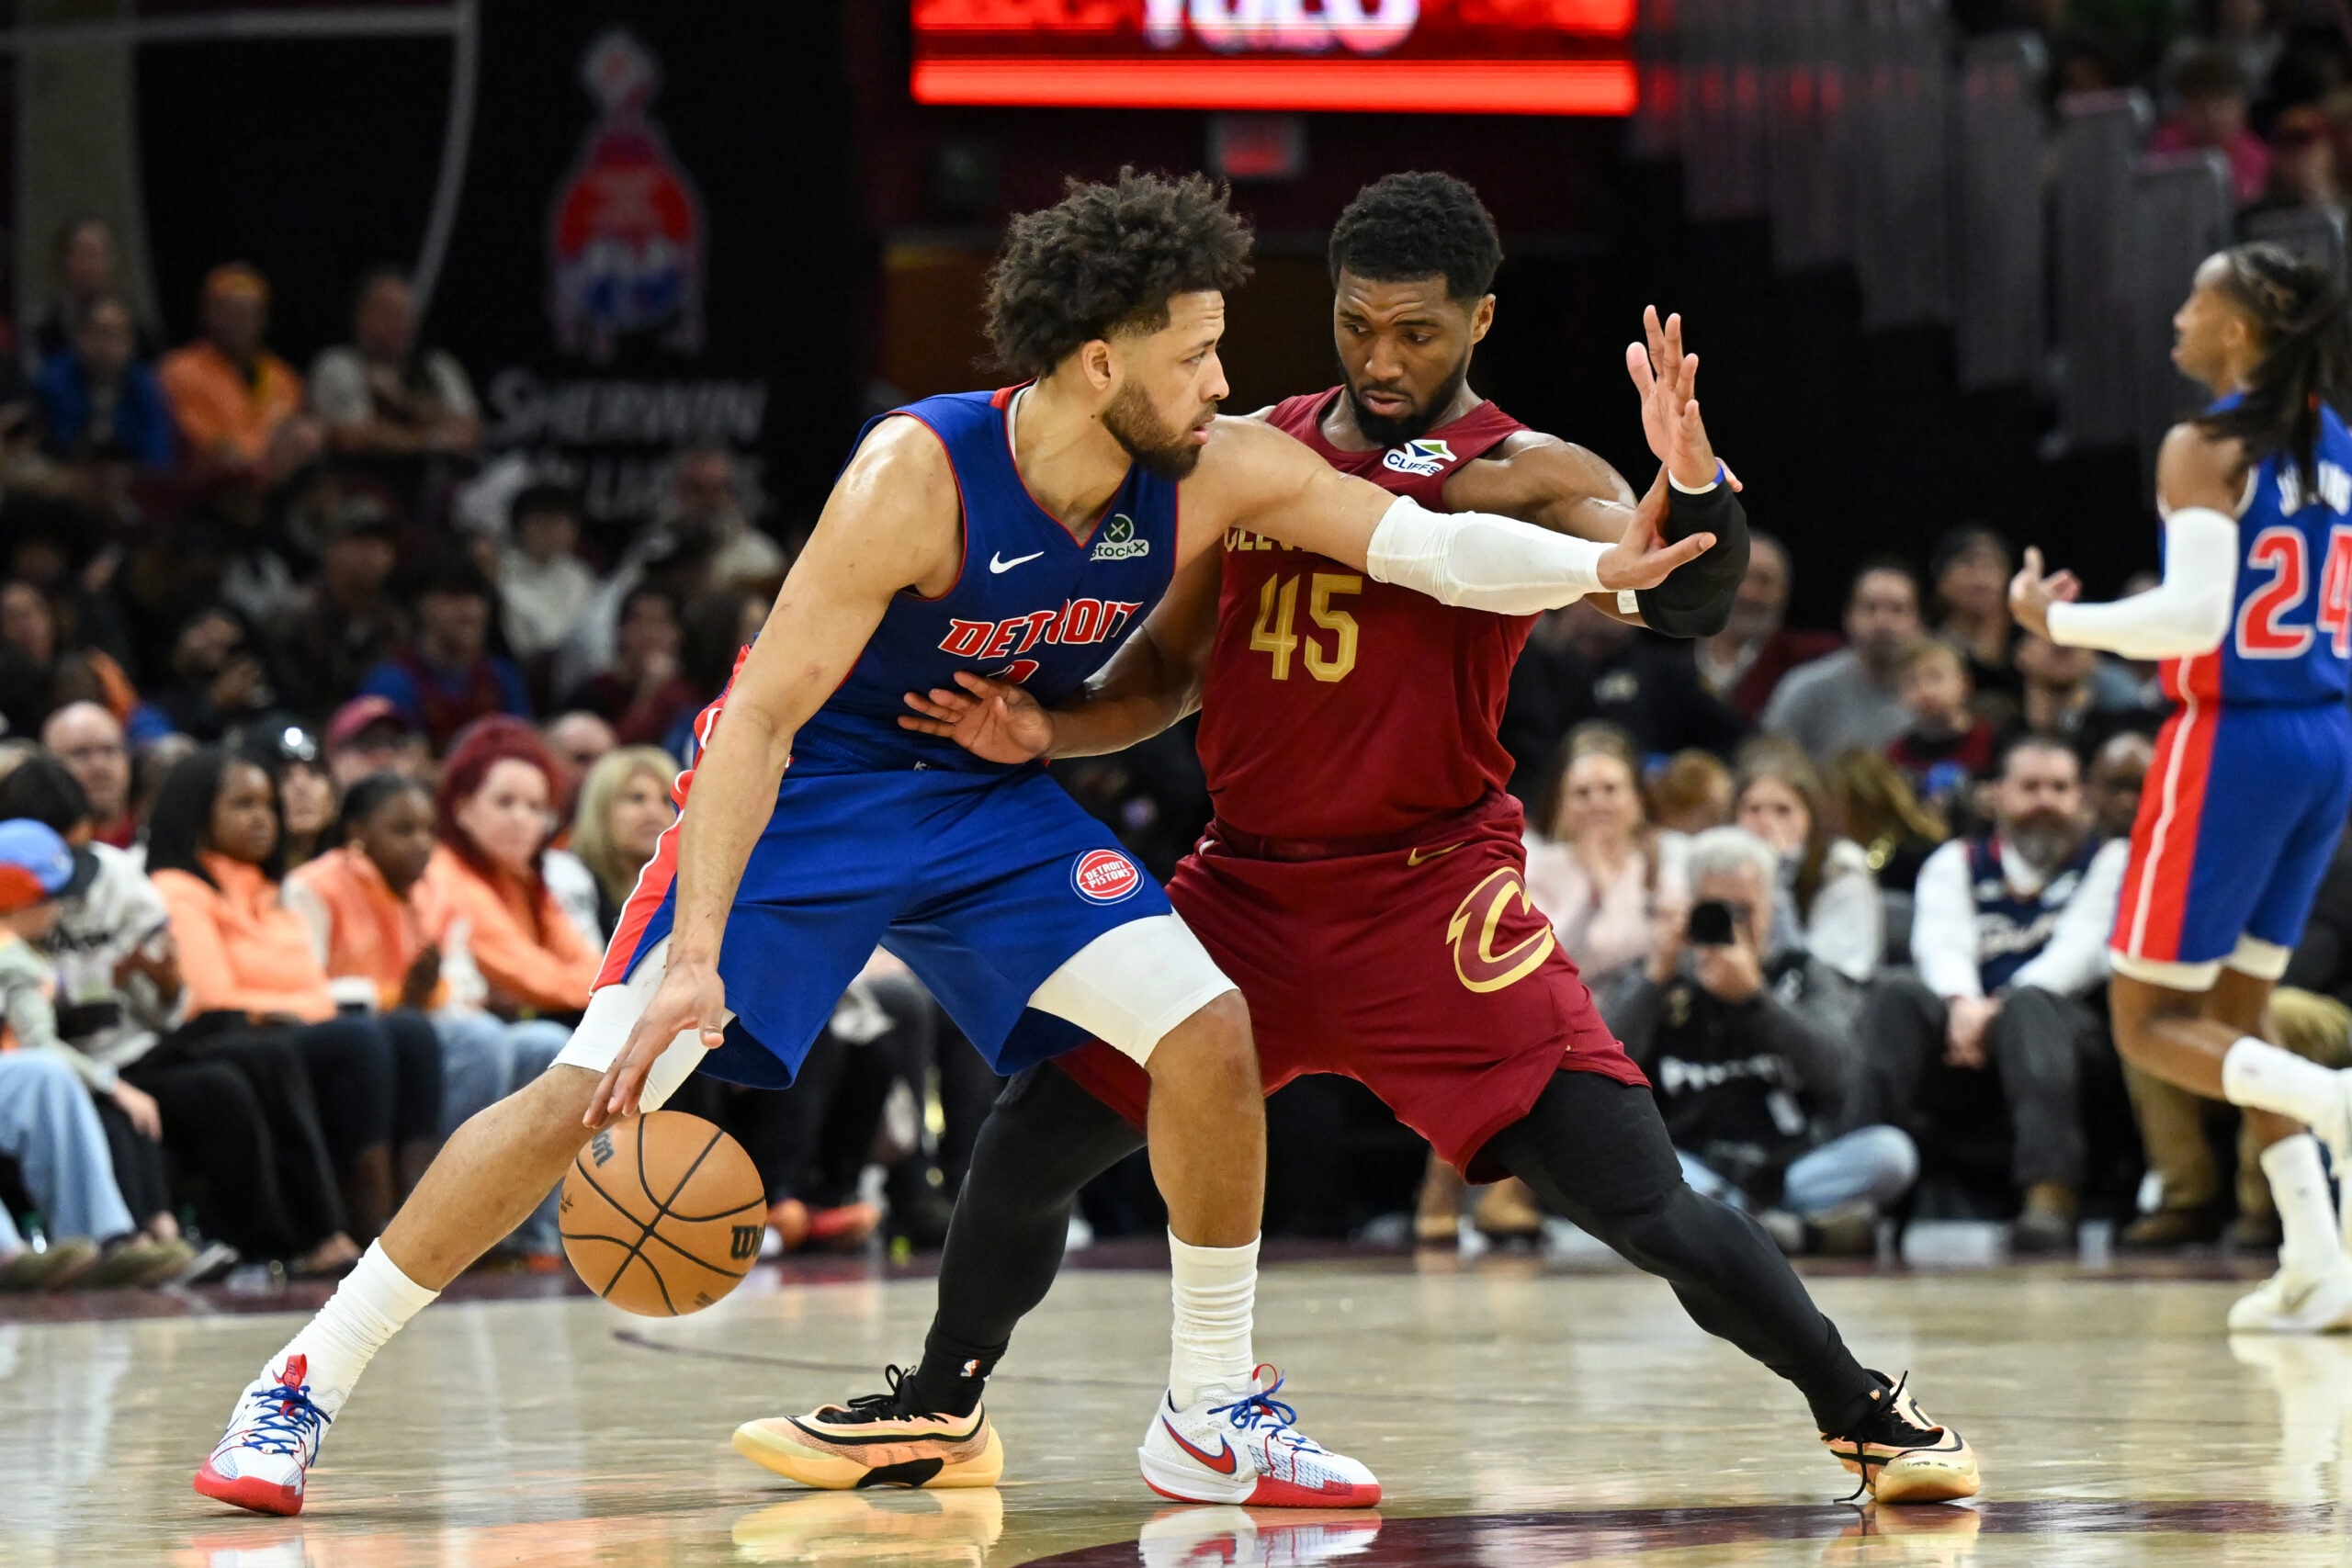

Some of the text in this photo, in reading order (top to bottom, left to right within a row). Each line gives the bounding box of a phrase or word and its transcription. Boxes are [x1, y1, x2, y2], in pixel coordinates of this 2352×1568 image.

[1387, 454, 1440, 474] CLIFFS
[1250, 573, 1363, 682] 45
[1084, 861, 1125, 881] DETROIT
[1088, 868, 1131, 888] PISTONS
